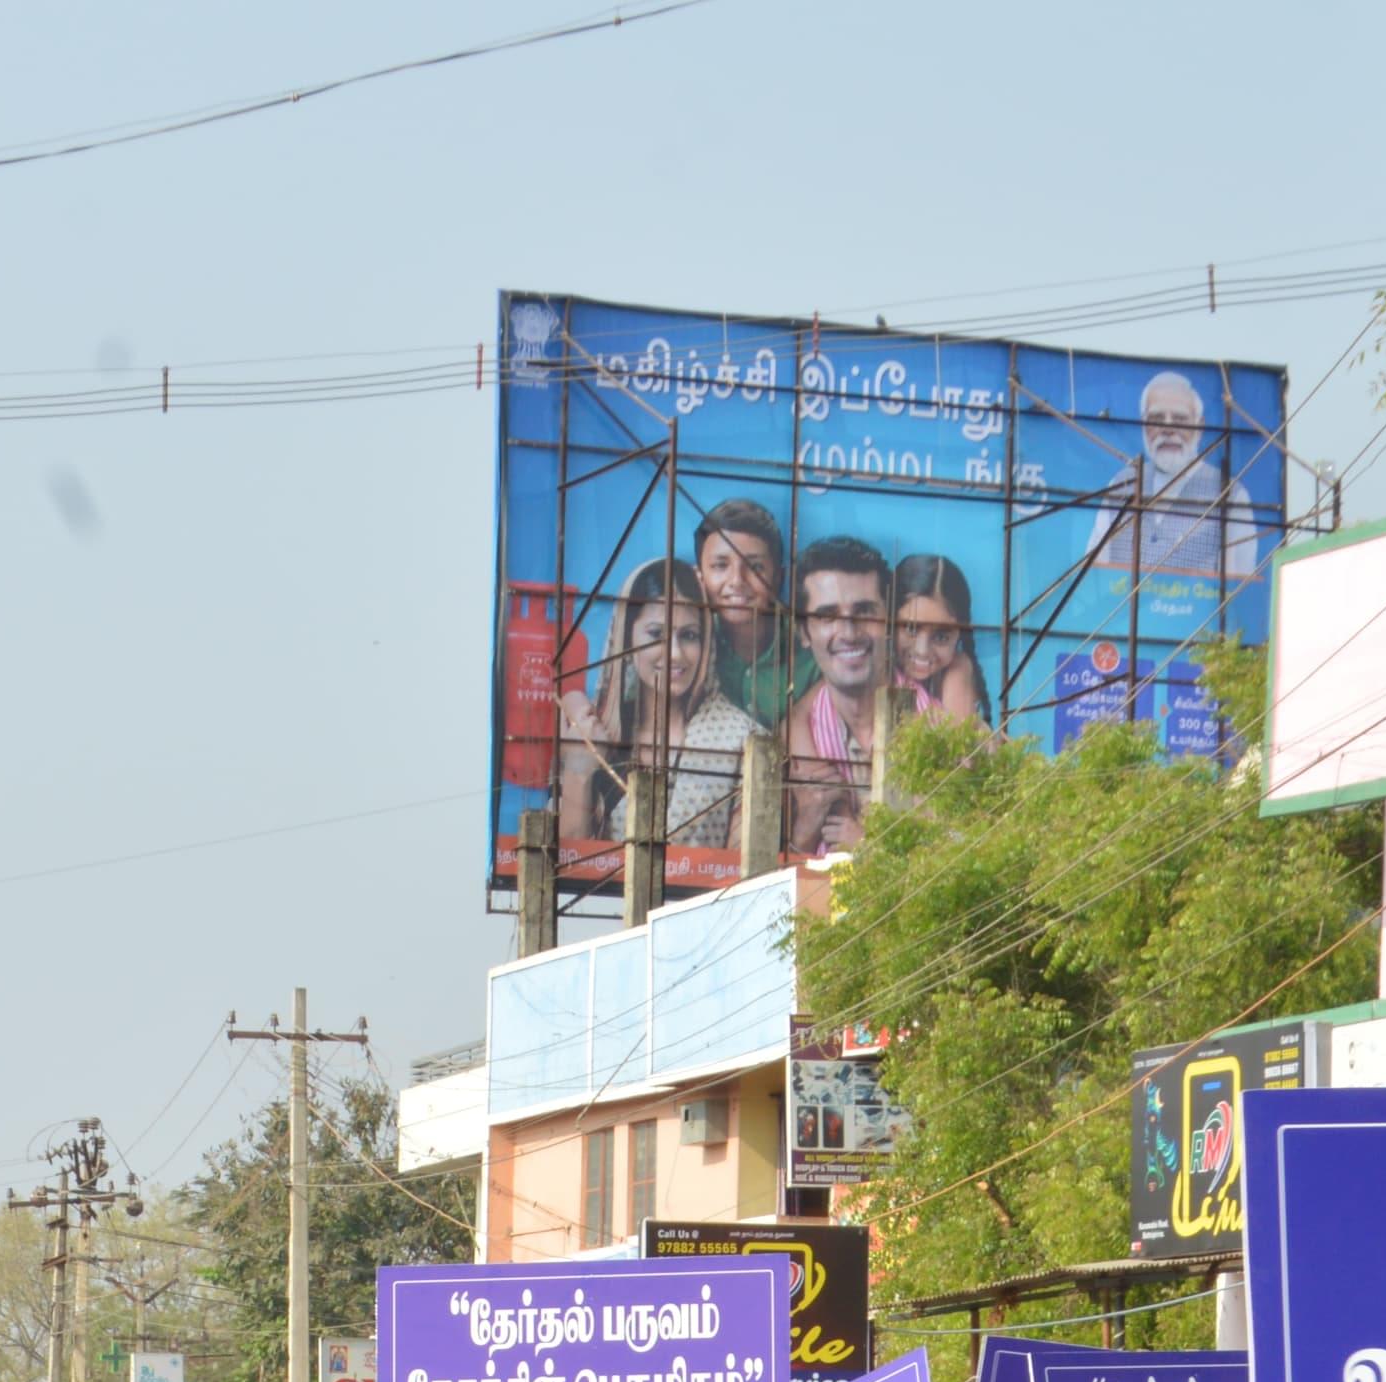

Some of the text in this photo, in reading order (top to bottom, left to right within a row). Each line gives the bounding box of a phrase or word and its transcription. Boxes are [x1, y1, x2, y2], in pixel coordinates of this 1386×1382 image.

[595, 336, 1005, 441] மகிழ்ச்சி இப்போது
[657, 1242, 738, 1254] 97882 55565
[449, 1284, 721, 1358] “தேர்தல் பருவம்
